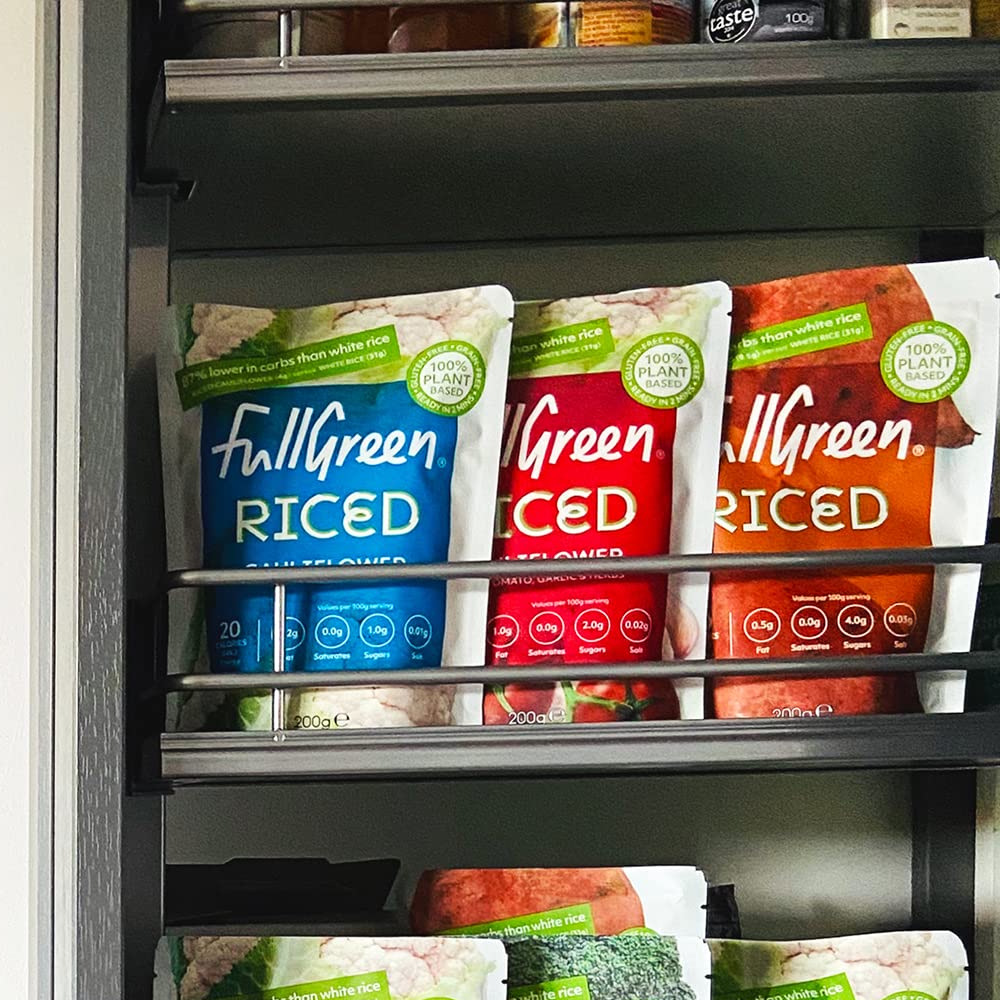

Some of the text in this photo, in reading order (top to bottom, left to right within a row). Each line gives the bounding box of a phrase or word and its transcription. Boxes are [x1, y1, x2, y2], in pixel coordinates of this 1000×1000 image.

[785, 12, 814, 26] 100g
[760, 311, 862, 344] than white rice
[540, 326, 604, 350] white rice
[906, 342, 946, 356] 100%
[209, 334, 390, 378] lower in carbs than white rice
[645, 352, 684, 364] 100%
[430, 360, 468, 372] 100%
[898, 356, 953, 370] PLANT
[638, 365, 688, 379] PLANT
[905, 371, 946, 382] BASED
[424, 373, 472, 386] PLANT
[646, 380, 682, 388] BASED
[430, 386, 464, 397] BASED
[632, 385, 658, 406] READY
[502, 394, 654, 480] lGreen
[236, 492, 420, 543] RICED
[494, 486, 637, 538] ICED
[582, 620, 604, 631] 2.0g
[624, 620, 649, 631] 0.02g
[750, 620, 774, 630] 0.5g
[798, 618, 820, 628] 0.0g
[844, 616, 867, 626] 4.0g
[220, 620, 241, 639] 20
[322, 627, 343, 638] 0.0g
[367, 625, 388, 636] 1.0g
[536, 623, 558, 633] 0.0g
[578, 646, 606, 655] Sugars
[756, 646, 770, 654] Fat
[790, 642, 830, 652] Saturates
[843, 641, 872, 650] Sugars
[313, 652, 351, 661] Saturates
[364, 652, 391, 661] Sugars
[528, 648, 566, 657] Saturates
[504, 912, 586, 937] than white rice
[320, 984, 356, 1000] white
[356, 980, 382, 994] rice
[558, 985, 582, 997] rice
[820, 982, 844, 996] rice
